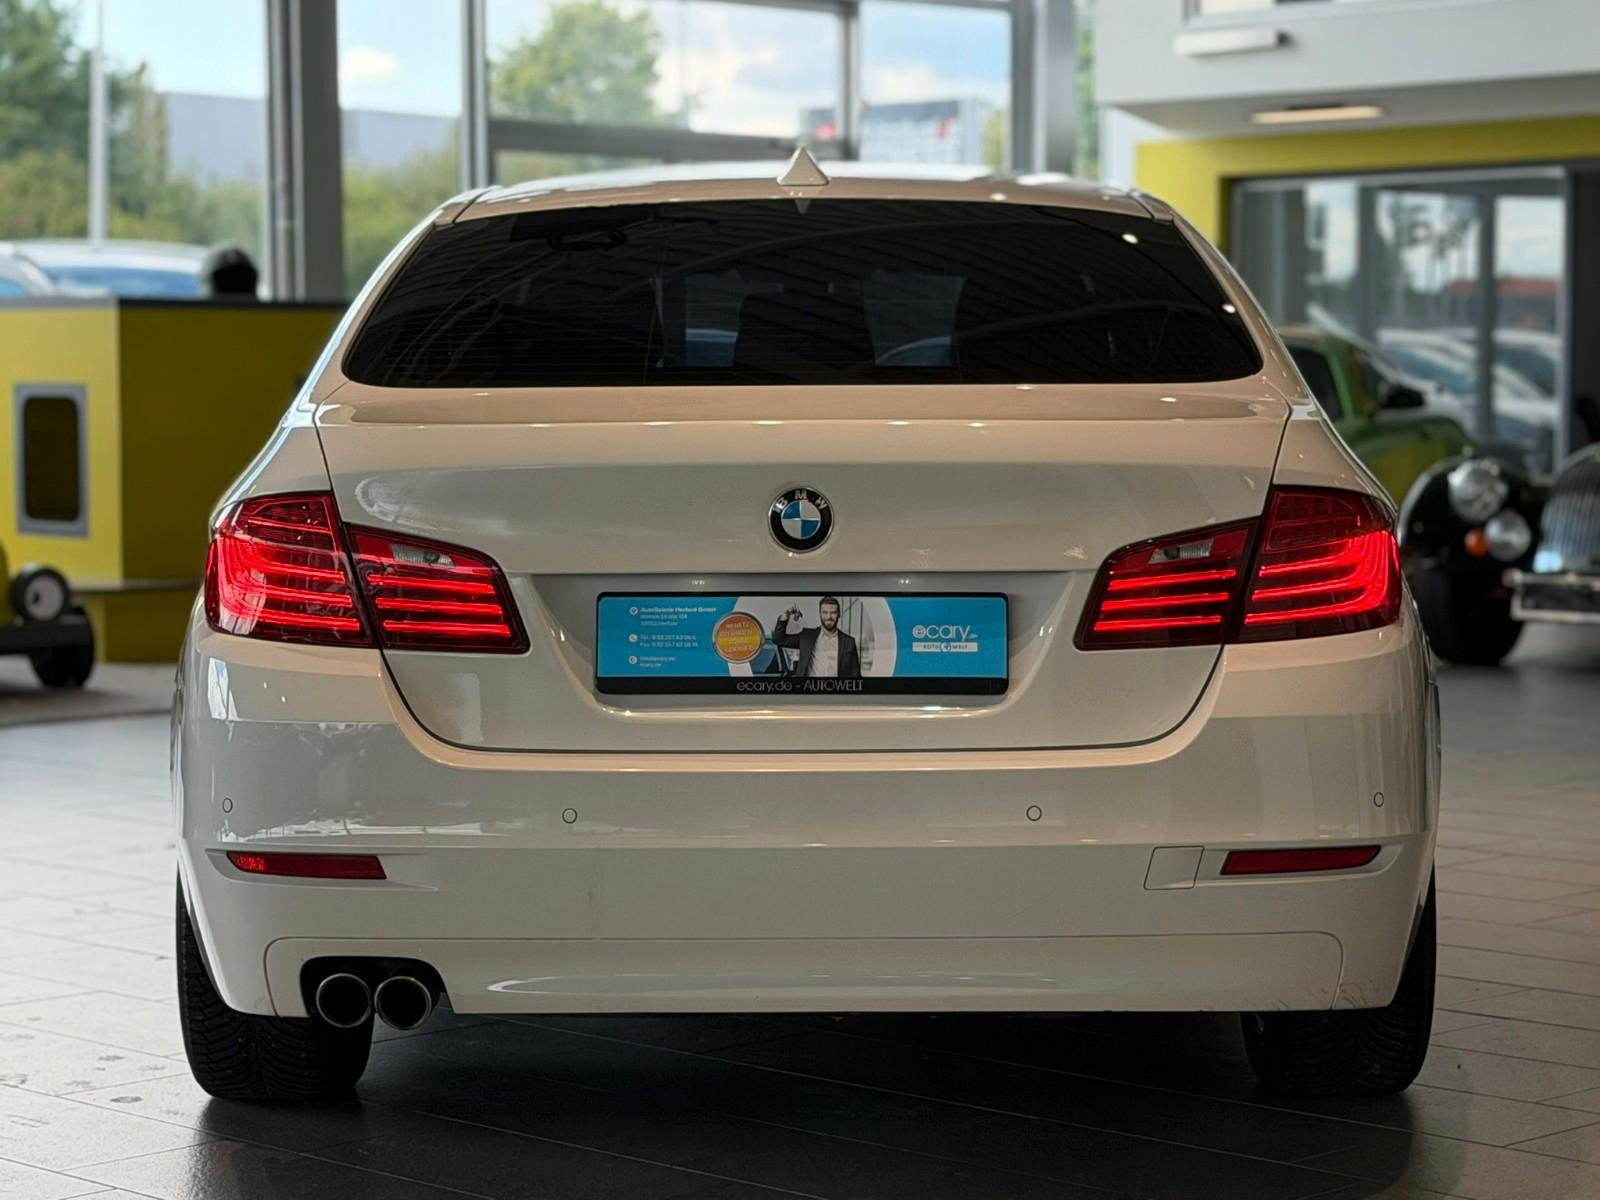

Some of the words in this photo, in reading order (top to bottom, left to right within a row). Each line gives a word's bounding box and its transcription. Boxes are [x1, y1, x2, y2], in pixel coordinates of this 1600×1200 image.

[774, 489, 828, 510] BMW
[736, 680, 793, 693] ecary.de
[803, 679, 864, 692] AUTOWELT
